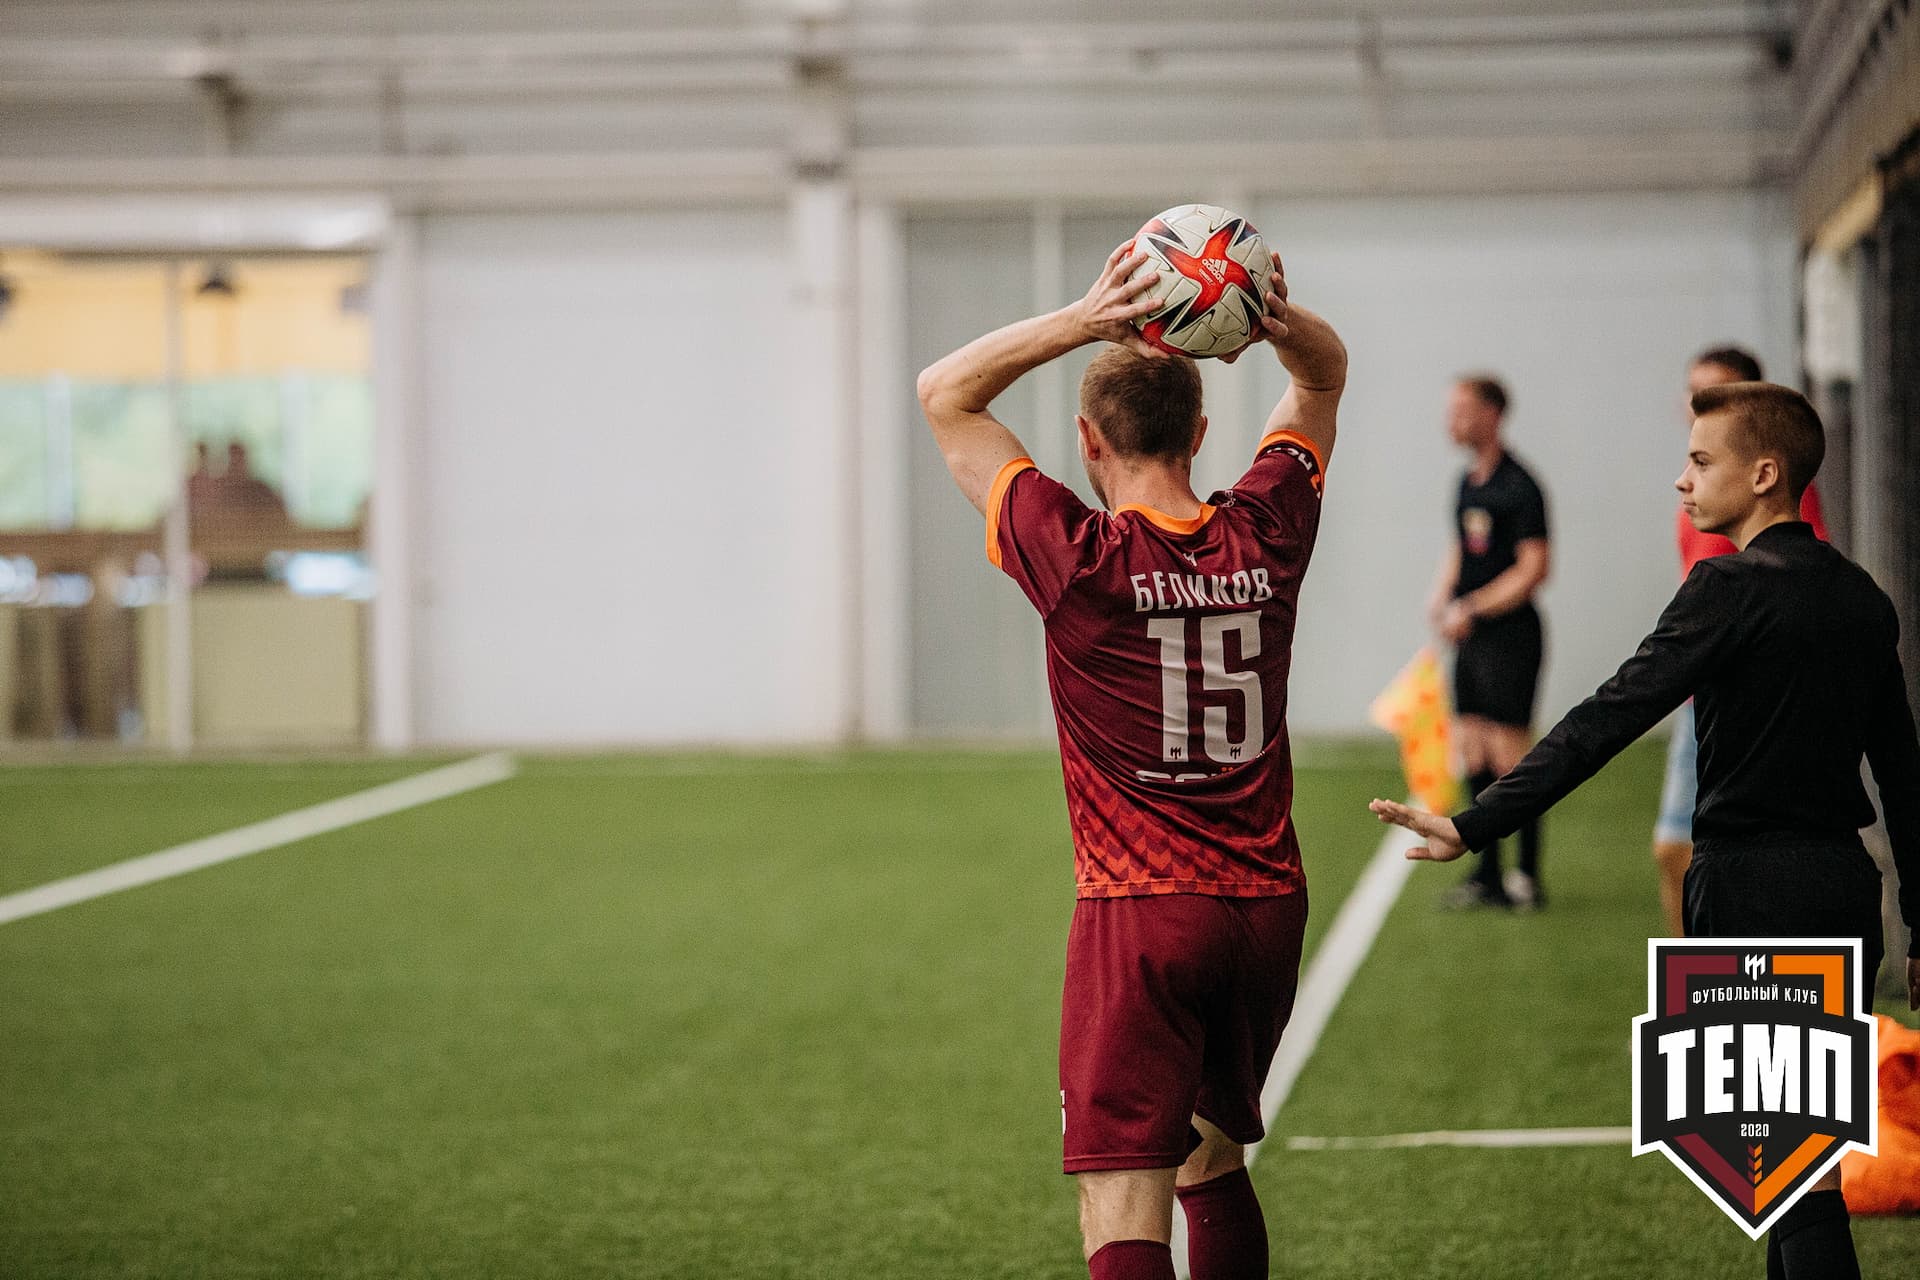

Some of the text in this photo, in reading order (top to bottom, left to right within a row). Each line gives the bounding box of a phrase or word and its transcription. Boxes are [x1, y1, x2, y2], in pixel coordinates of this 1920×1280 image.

[1202, 259, 1225, 284] adidas
[1130, 568, 1272, 612] БЕЛИКОВ
[1147, 610, 1264, 763] 15
